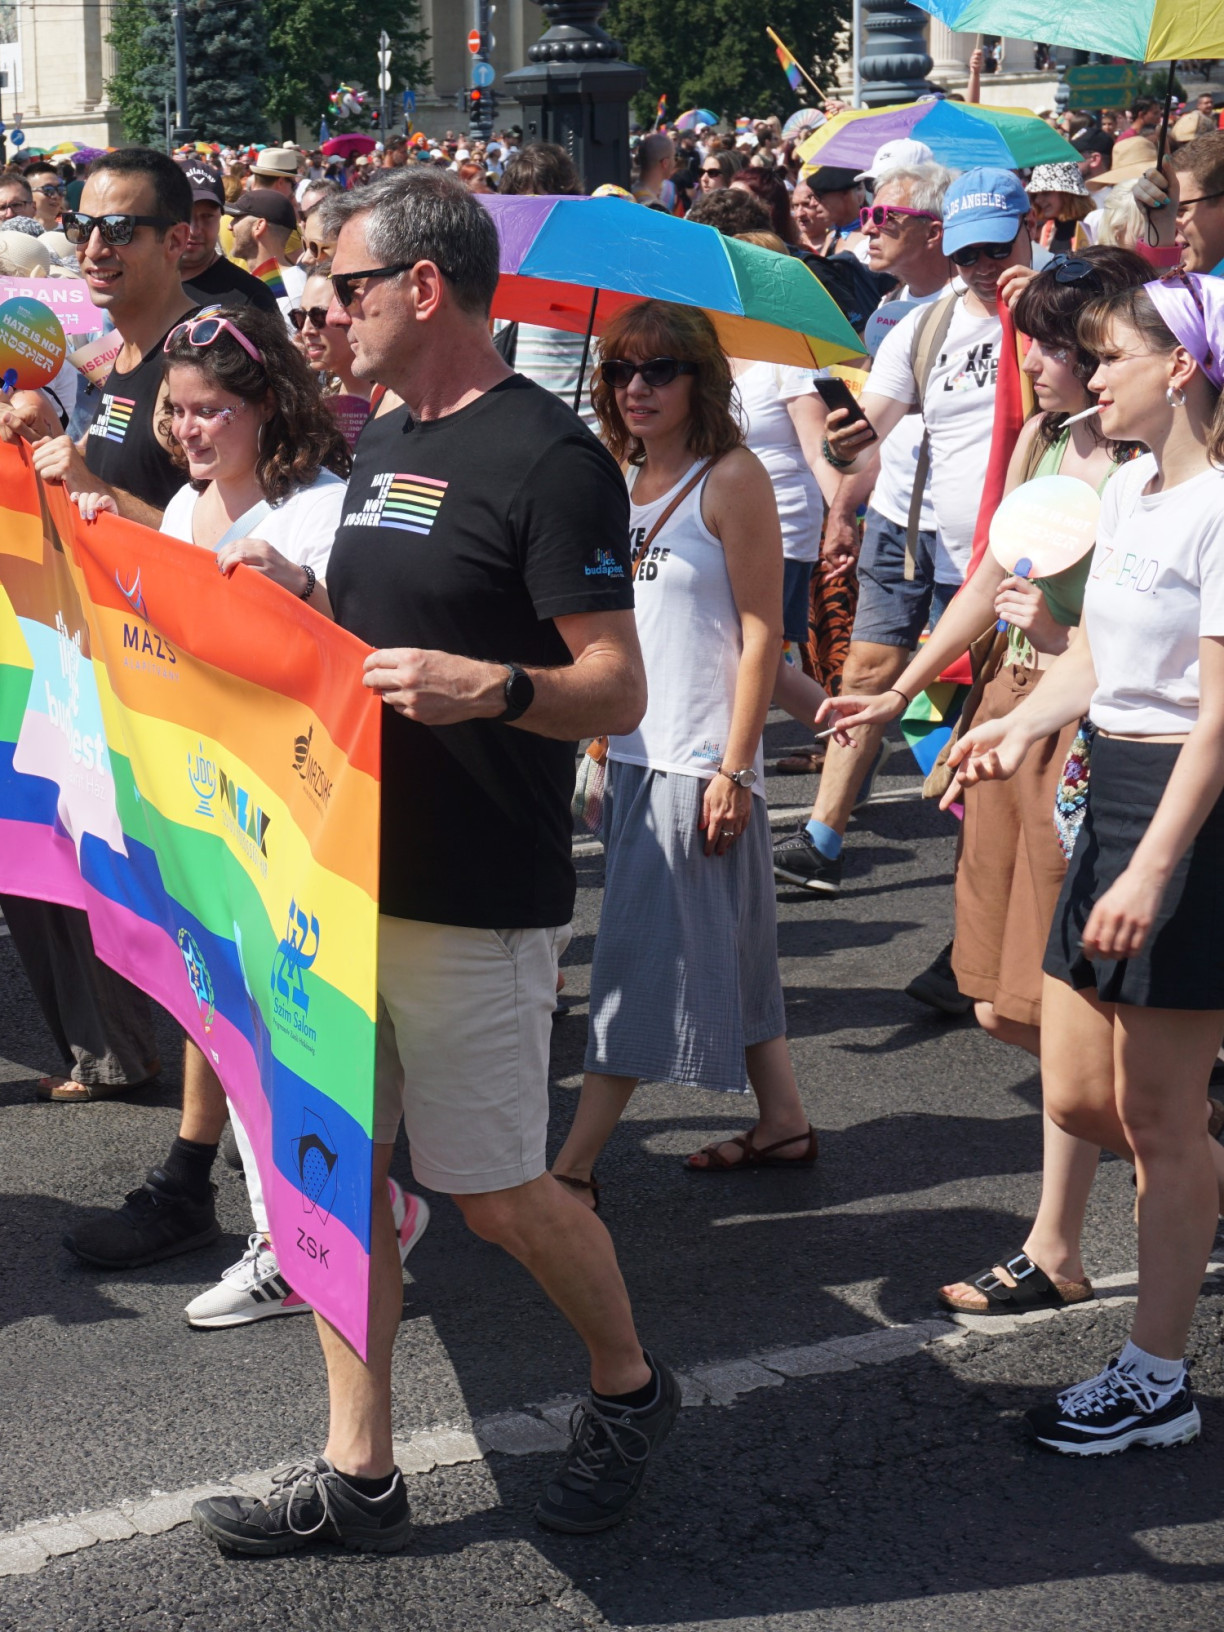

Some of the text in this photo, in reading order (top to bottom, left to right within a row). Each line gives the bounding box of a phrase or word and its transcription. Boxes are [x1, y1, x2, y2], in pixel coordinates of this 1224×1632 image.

[185, 167, 216, 183] allaway
[945, 192, 1007, 220] LOS ANGELES
[4, 287, 84, 303] TRANS
[2, 313, 30, 336] HATE
[29, 330, 41, 344] IS
[40, 339, 63, 358] NOT
[965, 358, 999, 373] AND
[370, 472, 396, 488] HATE
[377, 486, 391, 500] IS
[362, 499, 387, 513] NOT
[343, 512, 382, 527] KOSHER
[651, 547, 671, 562] BE
[585, 565, 623, 577] budapest
[123, 623, 176, 664] MAZS
[193, 755, 213, 787] JDC
[274, 997, 292, 1025] Szim
[293, 1010, 317, 1043] Salom
[296, 1226, 330, 1270] ZSK
